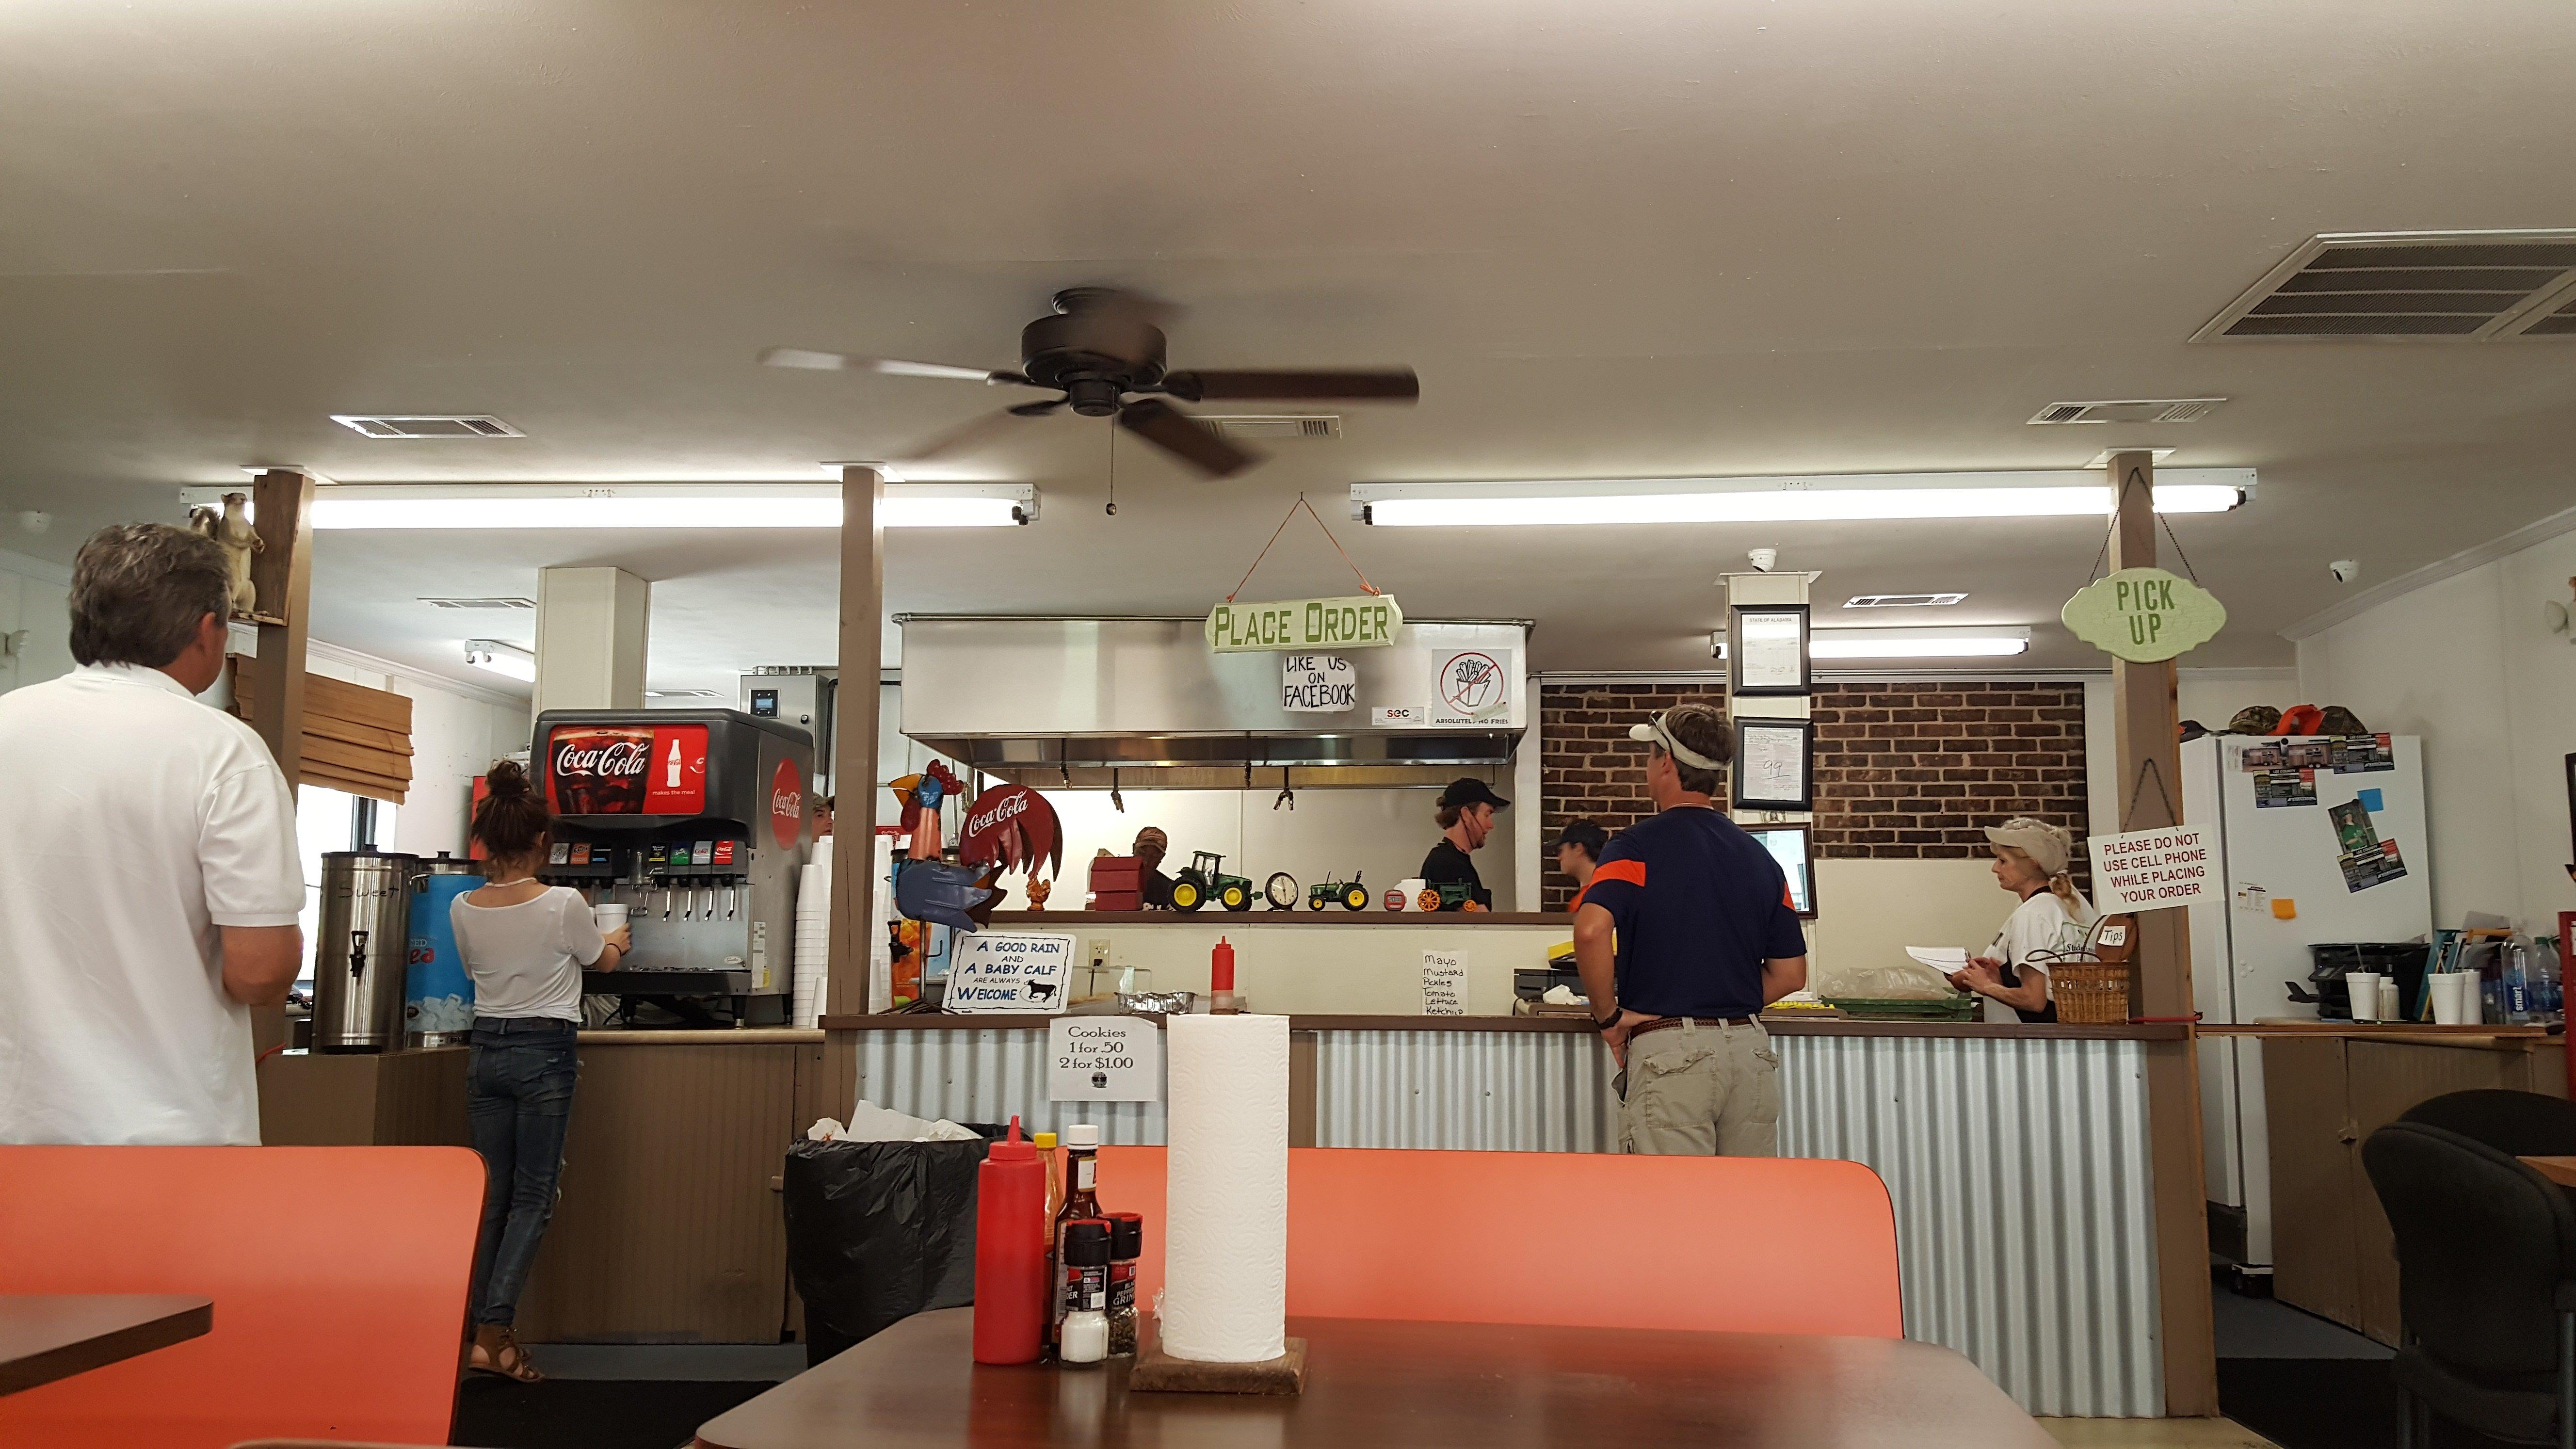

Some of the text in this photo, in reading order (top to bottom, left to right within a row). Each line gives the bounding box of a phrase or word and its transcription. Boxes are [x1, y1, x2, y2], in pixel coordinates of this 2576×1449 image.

[2116, 580, 2175, 611] PICK
[1214, 602, 1388, 646] PLACE ORDER
[2128, 613, 2161, 645] UP
[1286, 657, 1346, 673] LIKE US
[1308, 672, 1325, 684] ON
[1284, 684, 1355, 708] FACEBOOK
[556, 742, 650, 776] Coca-Cola
[1763, 760, 1782, 777] 99
[773, 788, 801, 819] Coca-Cola
[968, 789, 1029, 838] Coca-Cola
[2104, 833, 2199, 855] PLEASE DO NOT
[2103, 849, 2207, 872] USE CELL PHONE
[2110, 866, 2205, 888] WHILE PLACING
[2120, 883, 2201, 903] YOUR ORDER
[2104, 930, 2123, 944] Tips
[976, 940, 1060, 954] A GOOD RAIN
[964, 963, 1057, 976] A BABY CALF
[1424, 955, 1457, 967] Mayo
[1422, 986, 1456, 998] Tomato
[1068, 1026, 1126, 1037] Cookies
[1069, 1042, 1124, 1053] 1 for .50
[1059, 1056, 1134, 1070] 2 for $1.00
